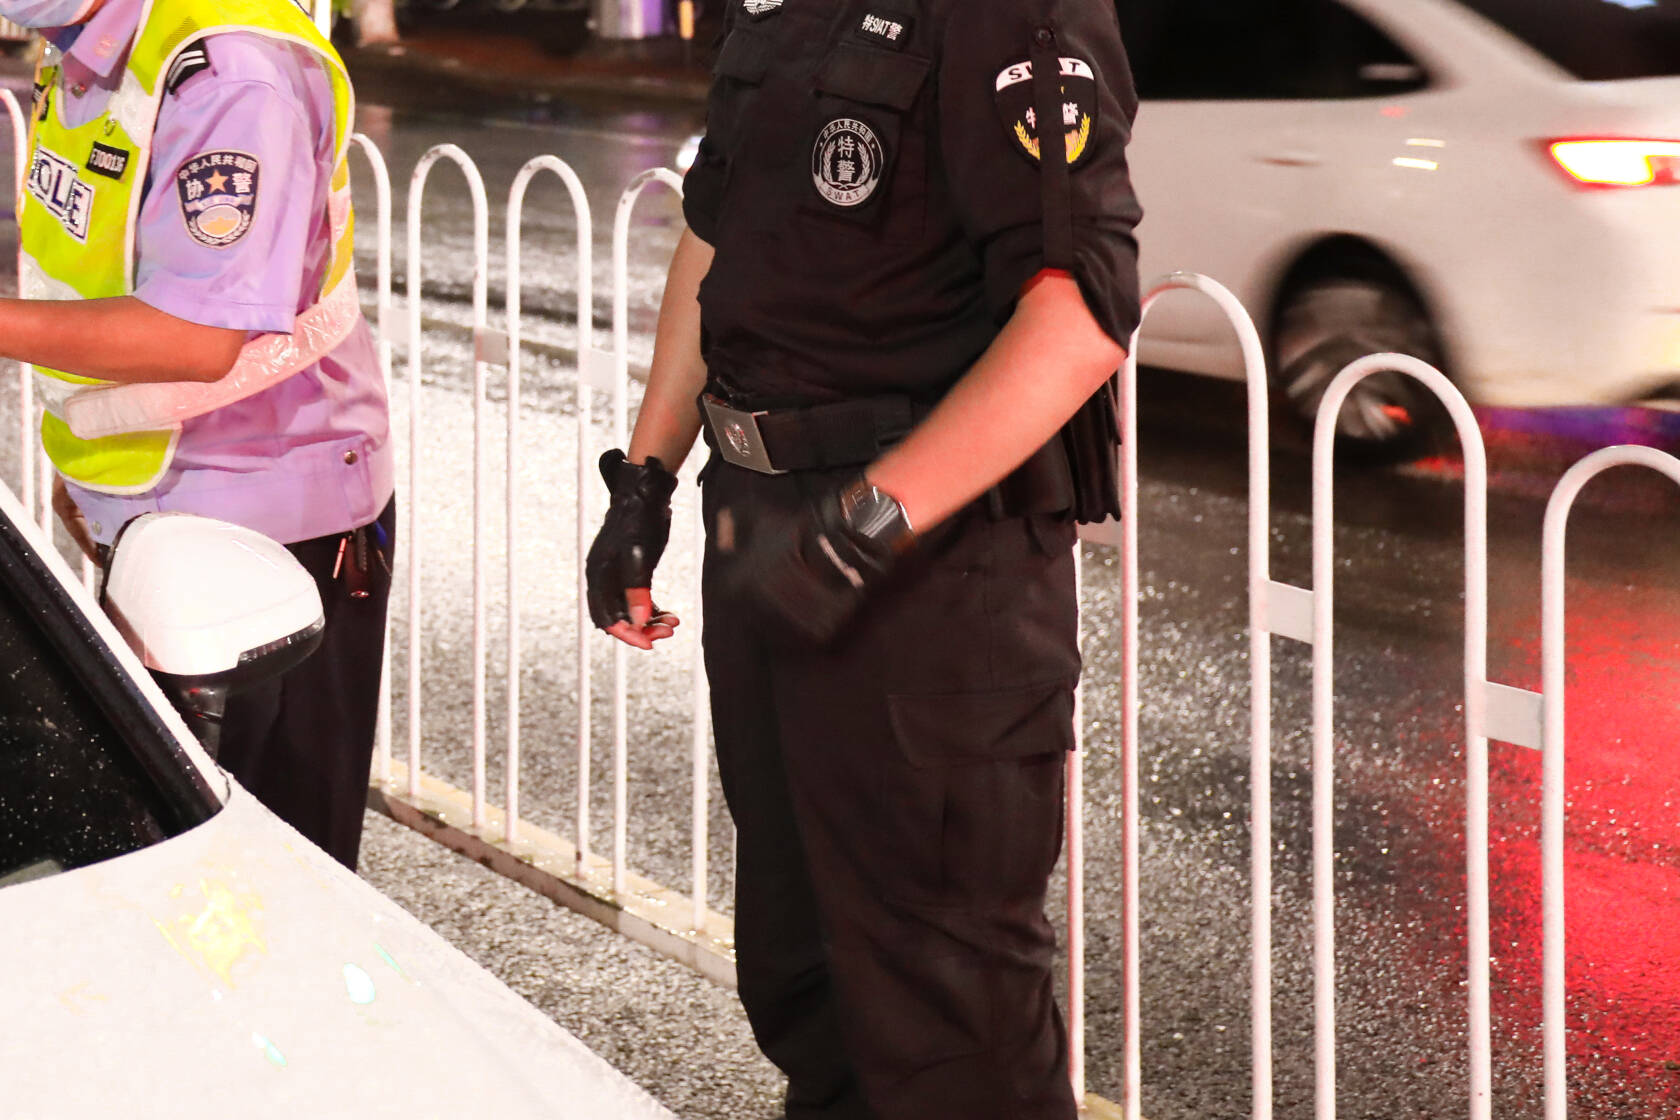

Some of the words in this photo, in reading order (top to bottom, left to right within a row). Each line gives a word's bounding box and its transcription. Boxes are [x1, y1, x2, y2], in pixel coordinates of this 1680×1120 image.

[1008, 62, 1080, 80] ST
[837, 136, 855, 182] 特警
[826, 187, 861, 201] SWAT
